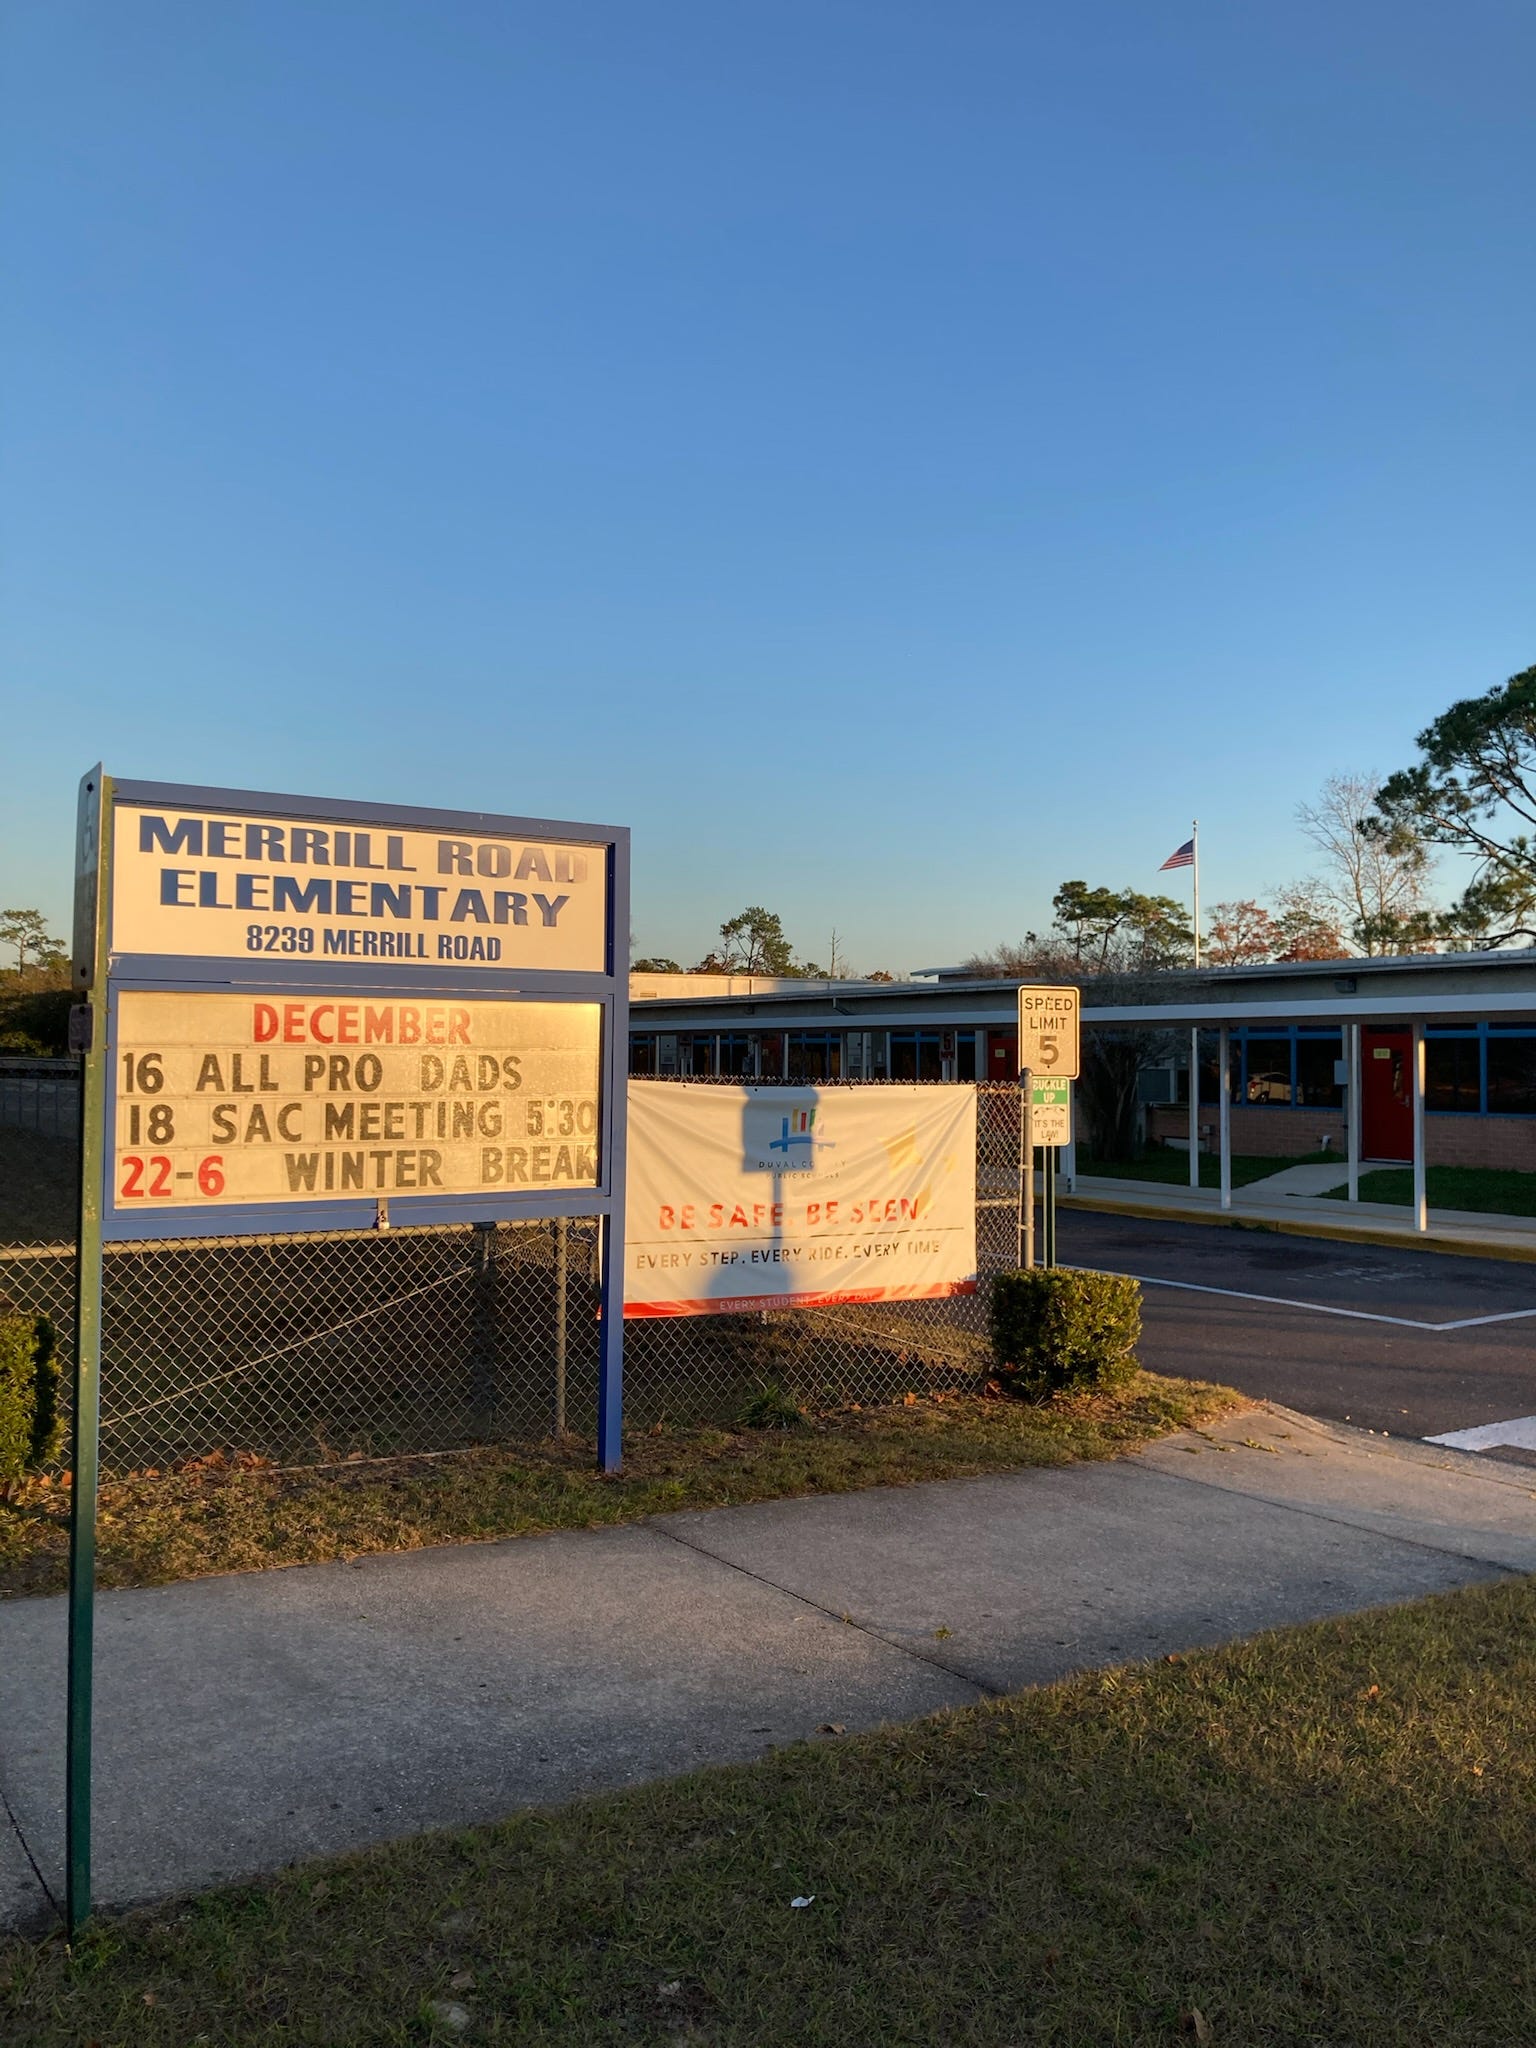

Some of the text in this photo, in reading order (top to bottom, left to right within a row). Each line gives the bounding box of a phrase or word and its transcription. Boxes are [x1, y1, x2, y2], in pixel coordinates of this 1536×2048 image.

[139, 816, 587, 883] MERRILL ROAD
[161, 869, 570, 927] ELEMENTARY
[247, 925, 501, 962] 8239 MERRILL ROAD
[1025, 997, 1072, 1010] SPEED
[254, 1004, 471, 1045] DECEMBER
[1030, 1018, 1066, 1029] LIMIT
[1040, 1036, 1059, 1064] 5
[123, 1053, 522, 1093] 16 ALL PRO DADS
[1033, 1080, 1065, 1090] BUCKLE
[1044, 1092, 1055, 1103] UP
[130, 1100, 597, 1145] 18 SAC MEETING 5:30
[121, 1144, 597, 1197] 22-6 WINTER BREAK
[659, 1205, 695, 1230] BE
[708, 1203, 793, 1228] SAFE.
[807, 1202, 839, 1225] BE
[637, 1253, 692, 1269] EVERY
[700, 1252, 745, 1266] STEP.
[752, 1249, 801, 1263] EVERY
[854, 1242, 899, 1258] EVERY
[720, 1301, 755, 1311] EVERY
